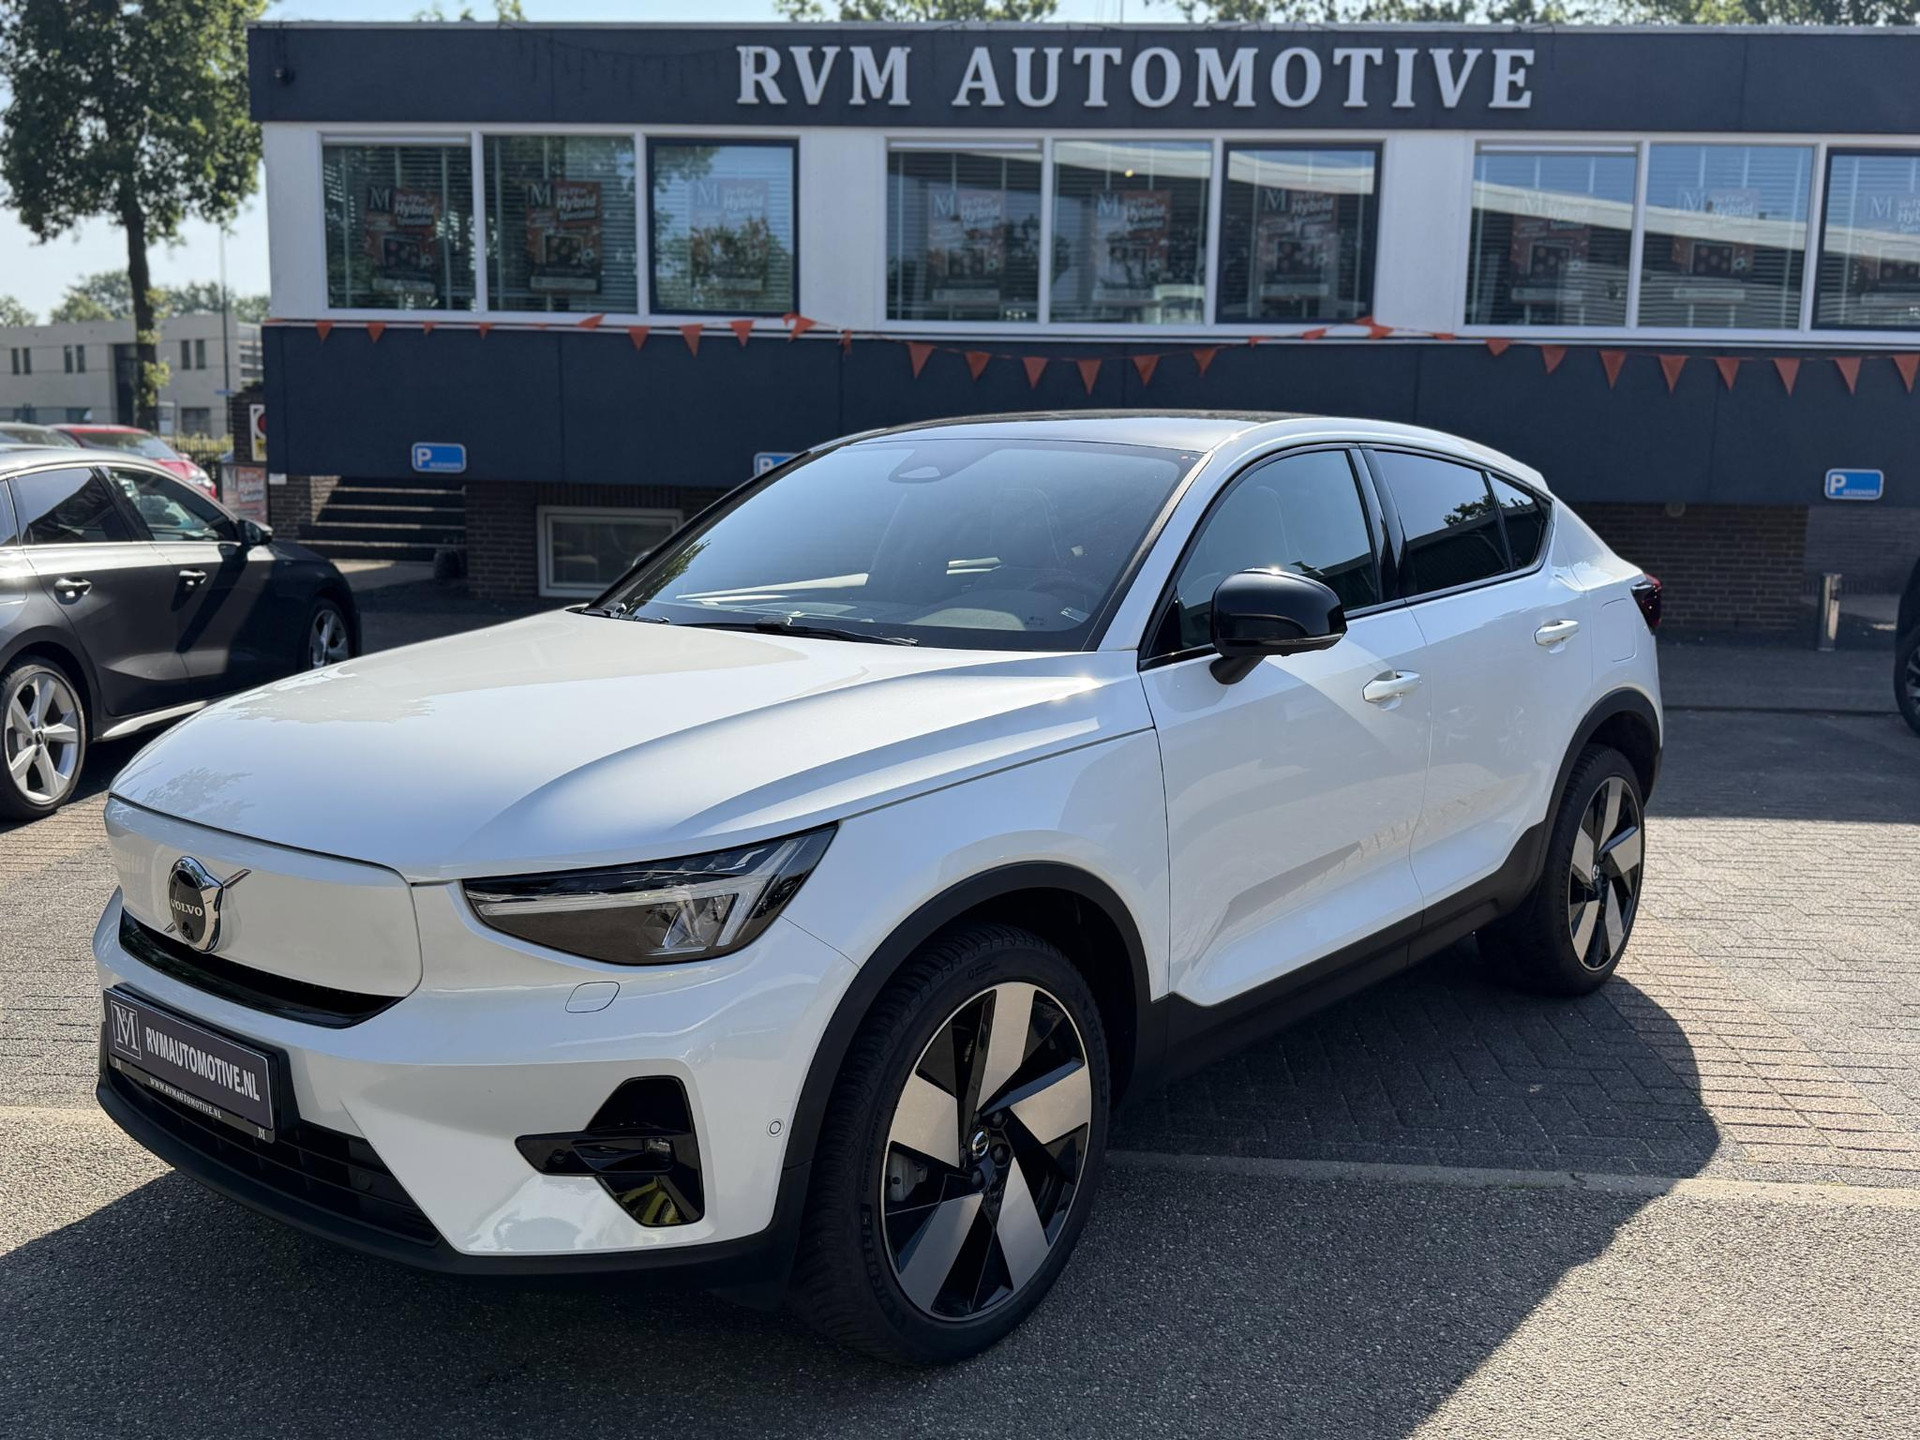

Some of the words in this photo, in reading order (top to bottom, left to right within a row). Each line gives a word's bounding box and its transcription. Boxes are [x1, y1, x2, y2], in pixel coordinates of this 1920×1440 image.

[736, 45, 912, 106] RVM
[951, 46, 1536, 109] AUTOMOTIVE
[416, 447, 432, 467] P
[1830, 474, 1847, 494] P
[145, 1027, 261, 1102] RVMAUTOMOTIVE.NL
